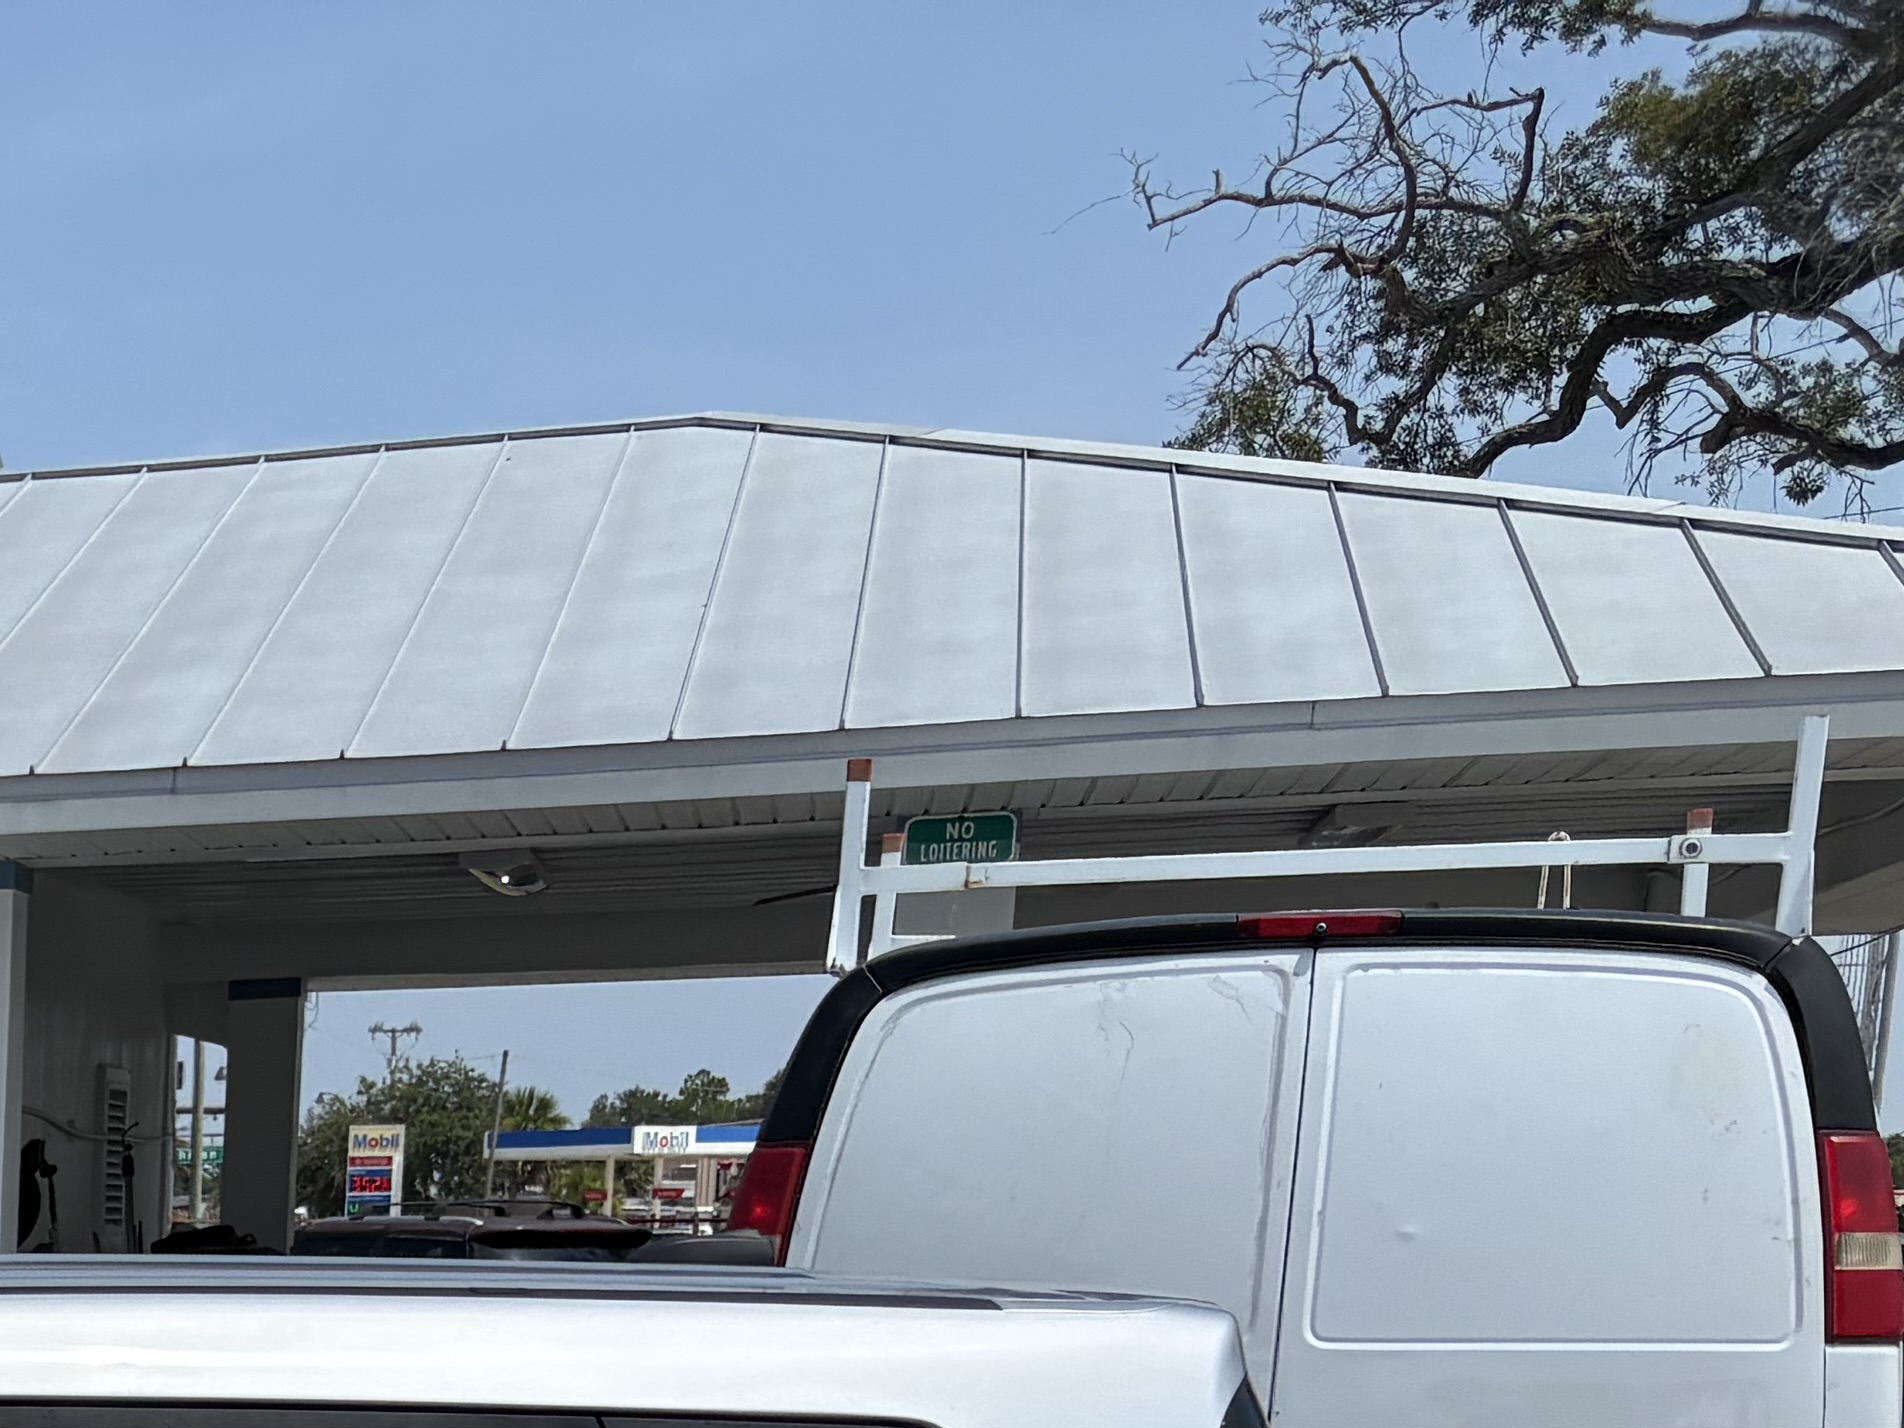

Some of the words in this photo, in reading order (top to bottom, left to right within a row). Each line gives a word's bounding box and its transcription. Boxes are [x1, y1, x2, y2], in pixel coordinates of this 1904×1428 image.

[946, 822, 974, 840] NO
[920, 840, 998, 862] LOITERING
[352, 1134, 400, 1151] Mobil
[643, 1131, 690, 1149] Mobil
